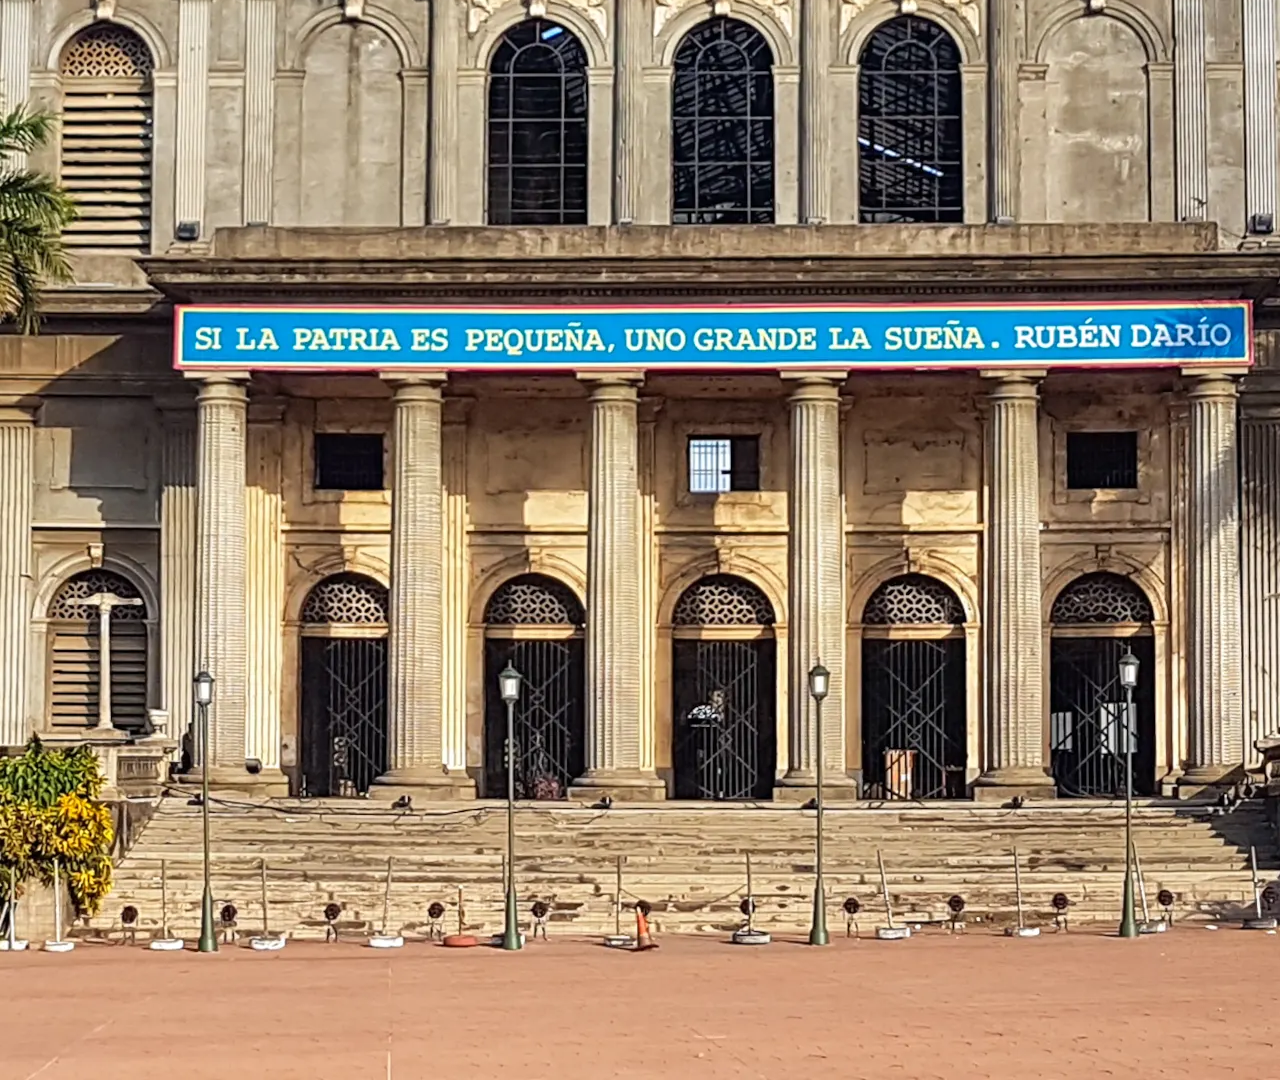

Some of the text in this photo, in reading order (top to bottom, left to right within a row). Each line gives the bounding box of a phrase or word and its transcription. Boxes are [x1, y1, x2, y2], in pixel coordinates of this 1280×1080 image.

[195, 327, 222, 351] SI
[235, 327, 280, 351] LA
[292, 327, 401, 351] PATRIA
[410, 327, 449, 352] ES
[464, 322, 615, 356] PEQUEÑA,
[624, 328, 686, 352] UNO
[693, 327, 817, 352] GRANDE
[827, 327, 872, 351] LA
[1014, 317, 1122, 349] RUBÉN
[1130, 316, 1231, 348] DARÍO
